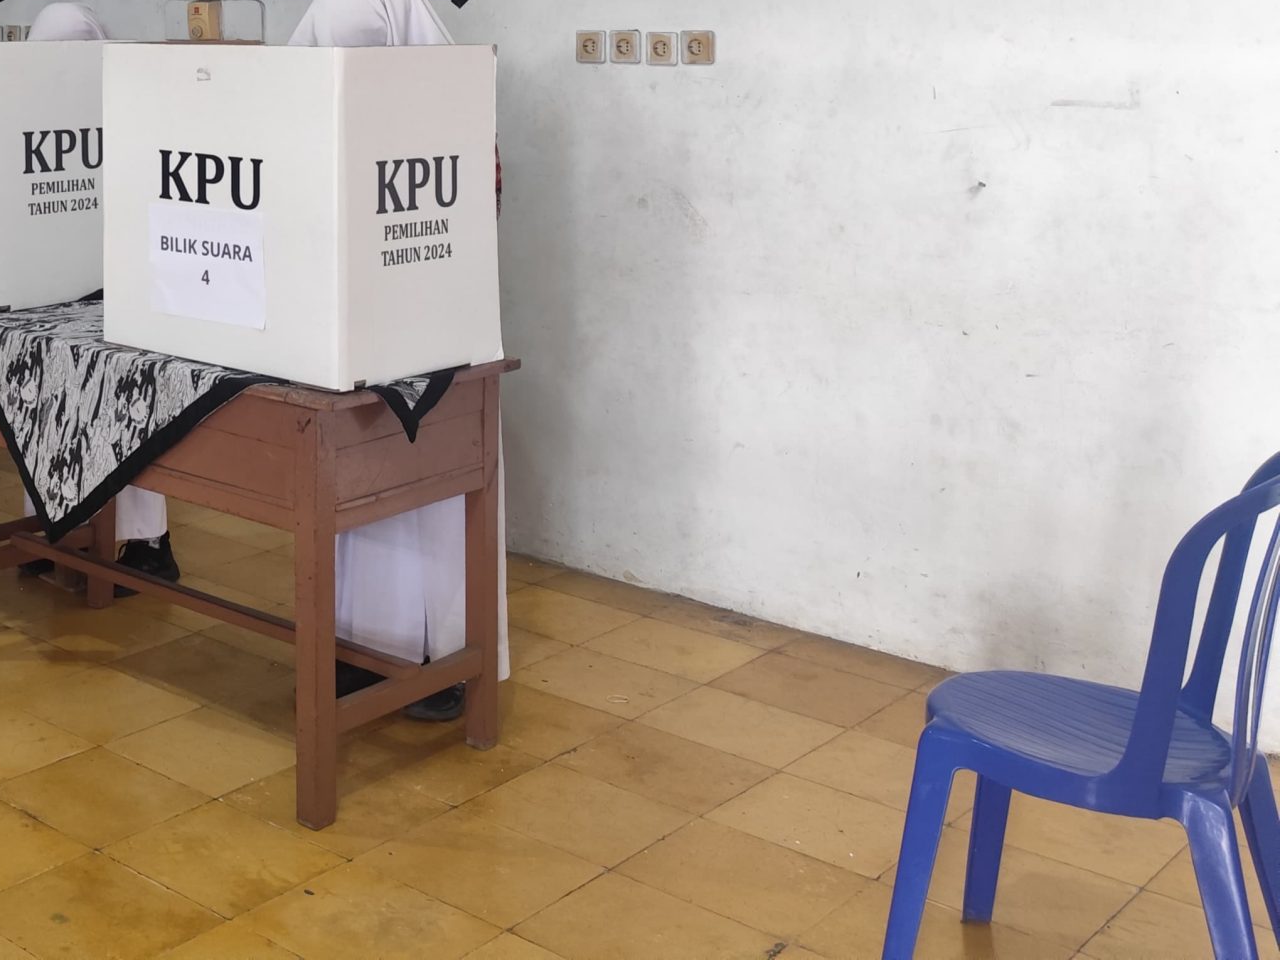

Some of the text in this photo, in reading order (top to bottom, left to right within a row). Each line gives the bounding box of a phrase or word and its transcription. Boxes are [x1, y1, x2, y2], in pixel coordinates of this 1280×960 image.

[22, 127, 103, 174] KPU
[31, 177, 95, 196] PEMILIHAN
[159, 149, 264, 211] KPU
[375, 155, 460, 215] KPU
[28, 197, 99, 216] TAHUN 2024
[383, 218, 449, 242] PEMILIHAN
[160, 235, 253, 263] BILIK SUARA
[381, 242, 453, 267] TAHUN 2024
[201, 269, 211, 286] 4
